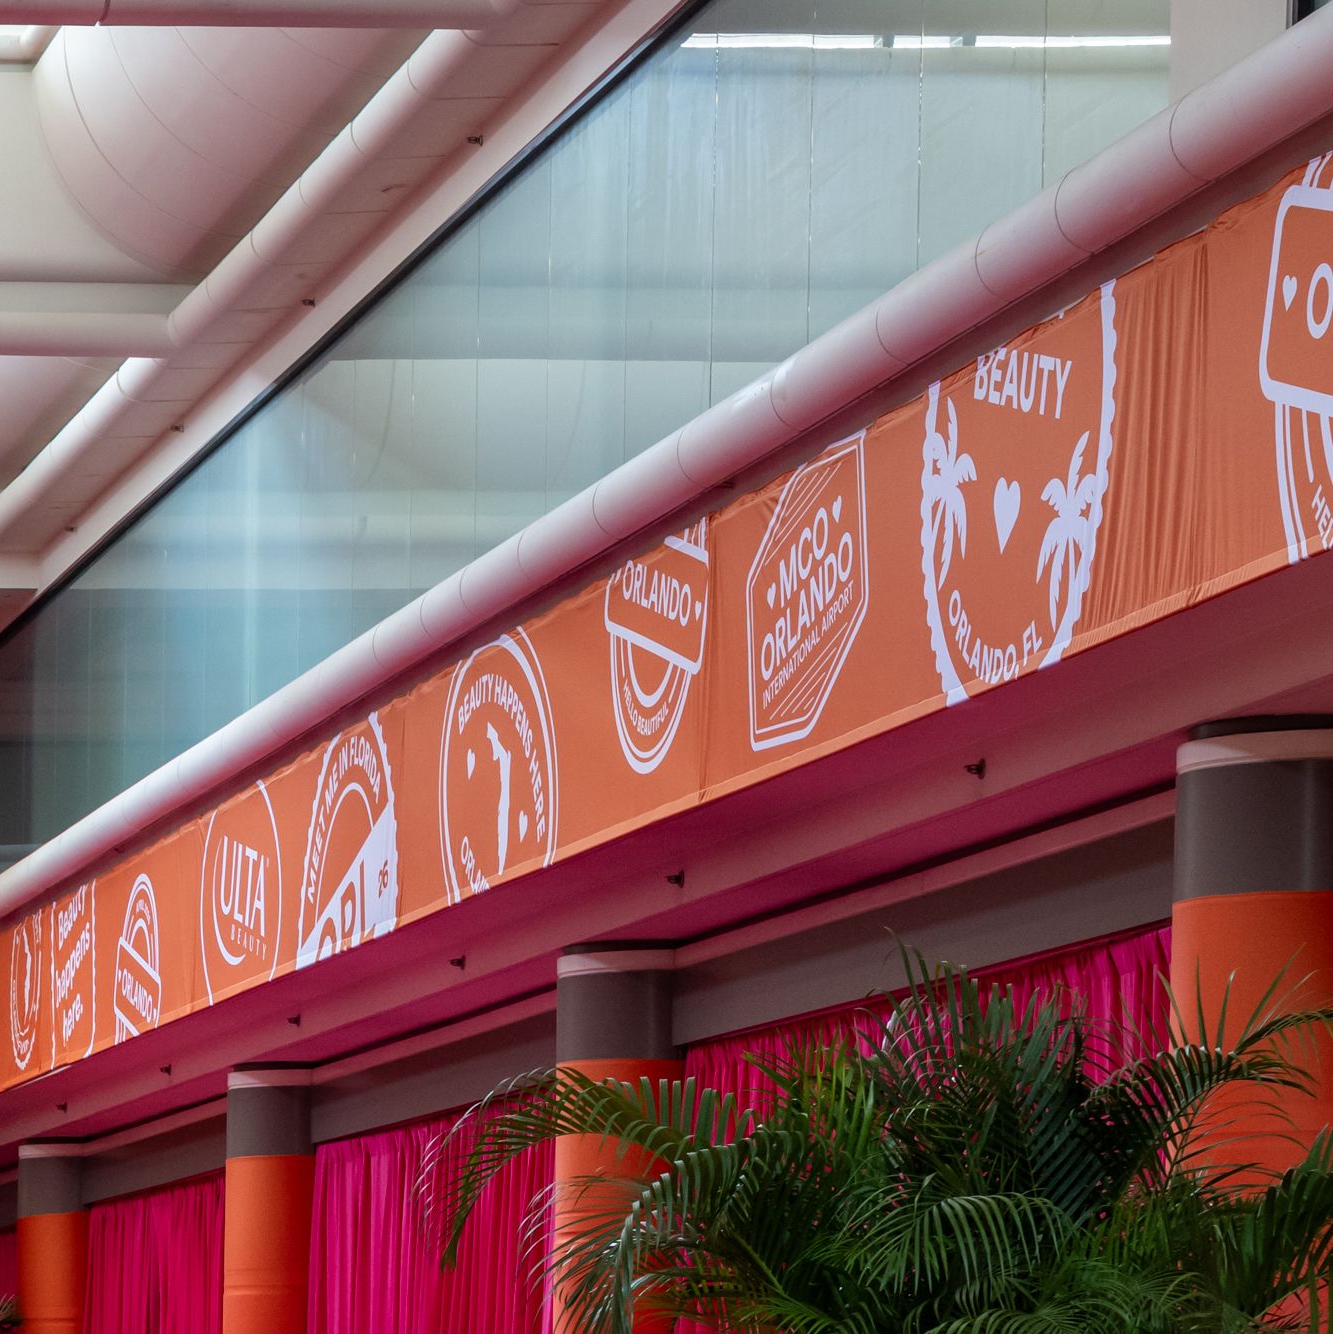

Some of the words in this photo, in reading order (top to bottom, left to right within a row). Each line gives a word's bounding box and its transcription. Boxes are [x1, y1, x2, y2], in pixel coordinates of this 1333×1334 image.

[973, 348, 1072, 419] BEAUTY
[622, 559, 692, 627] ORLANDO
[779, 507, 829, 608] MCO
[760, 532, 853, 681] ORLANDO
[762, 630, 820, 709] INTERNATIONAL
[820, 580, 853, 638] AIRPORT
[1021, 620, 1043, 667] FL
[623, 679, 638, 727] HELLO
[636, 702, 670, 736] BEAUTIFUL
[458, 674, 494, 735] BEAUTY
[494, 675, 532, 758] HAPPENS
[529, 749, 546, 843] HERE
[307, 805, 326, 904] MEET
[324, 763, 339, 814] ME
[339, 748, 348, 780] IN
[349, 736, 381, 804] FLORIDA
[57, 883, 89, 951] Beauty
[220, 835, 265, 938] ULTA
[55, 922, 90, 1009] happens
[230, 924, 267, 960] BEAUTY
[62, 993, 83, 1048] here.
[121, 968, 153, 1023] ORLANDO
